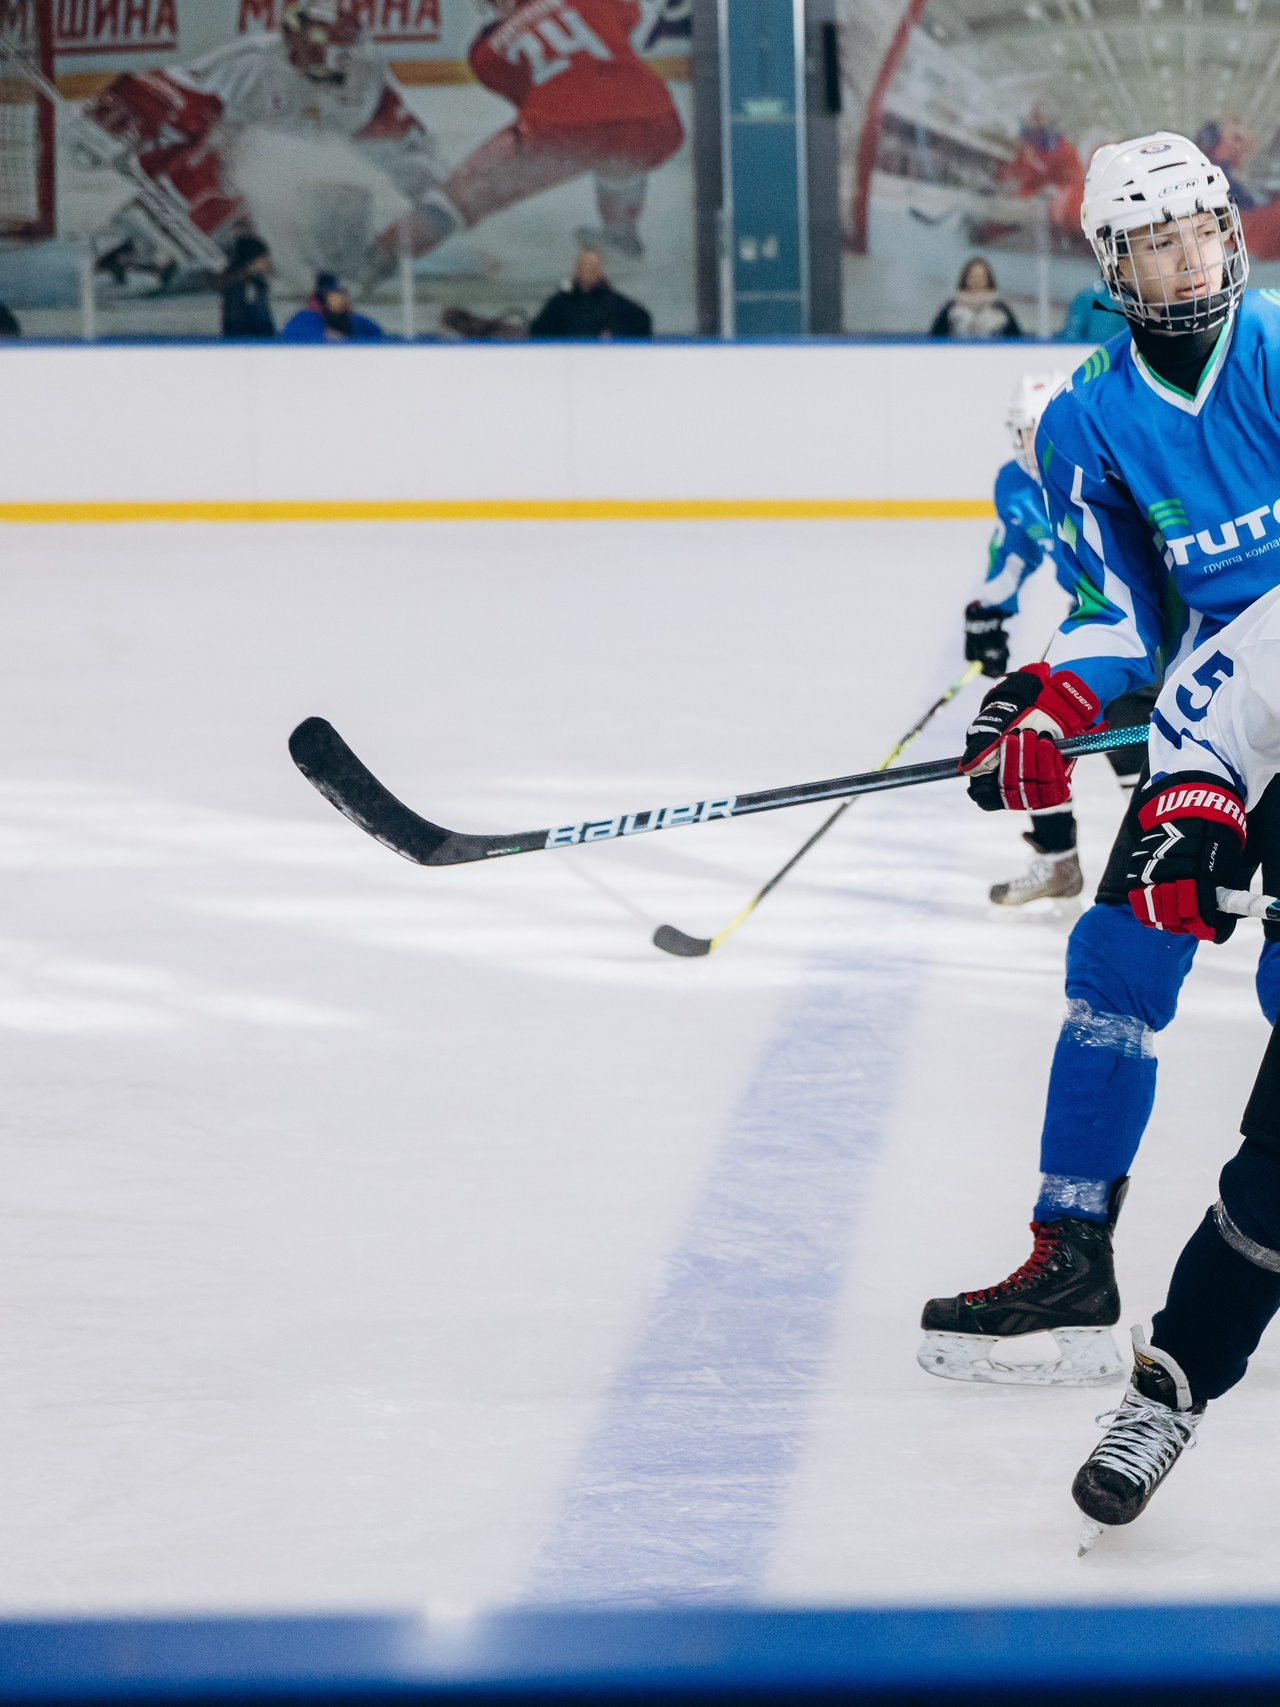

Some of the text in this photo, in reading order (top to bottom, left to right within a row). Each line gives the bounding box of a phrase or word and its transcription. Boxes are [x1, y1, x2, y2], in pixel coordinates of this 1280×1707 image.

[506, 9, 612, 84] 24
[1162, 181, 1197, 195] CCM
[1203, 554, 1243, 574] группа
[1061, 681, 1093, 712] BAUER
[1175, 649, 1235, 723] 5
[544, 795, 738, 850] BAUER
[1208, 842, 1220, 872] ALPHA
